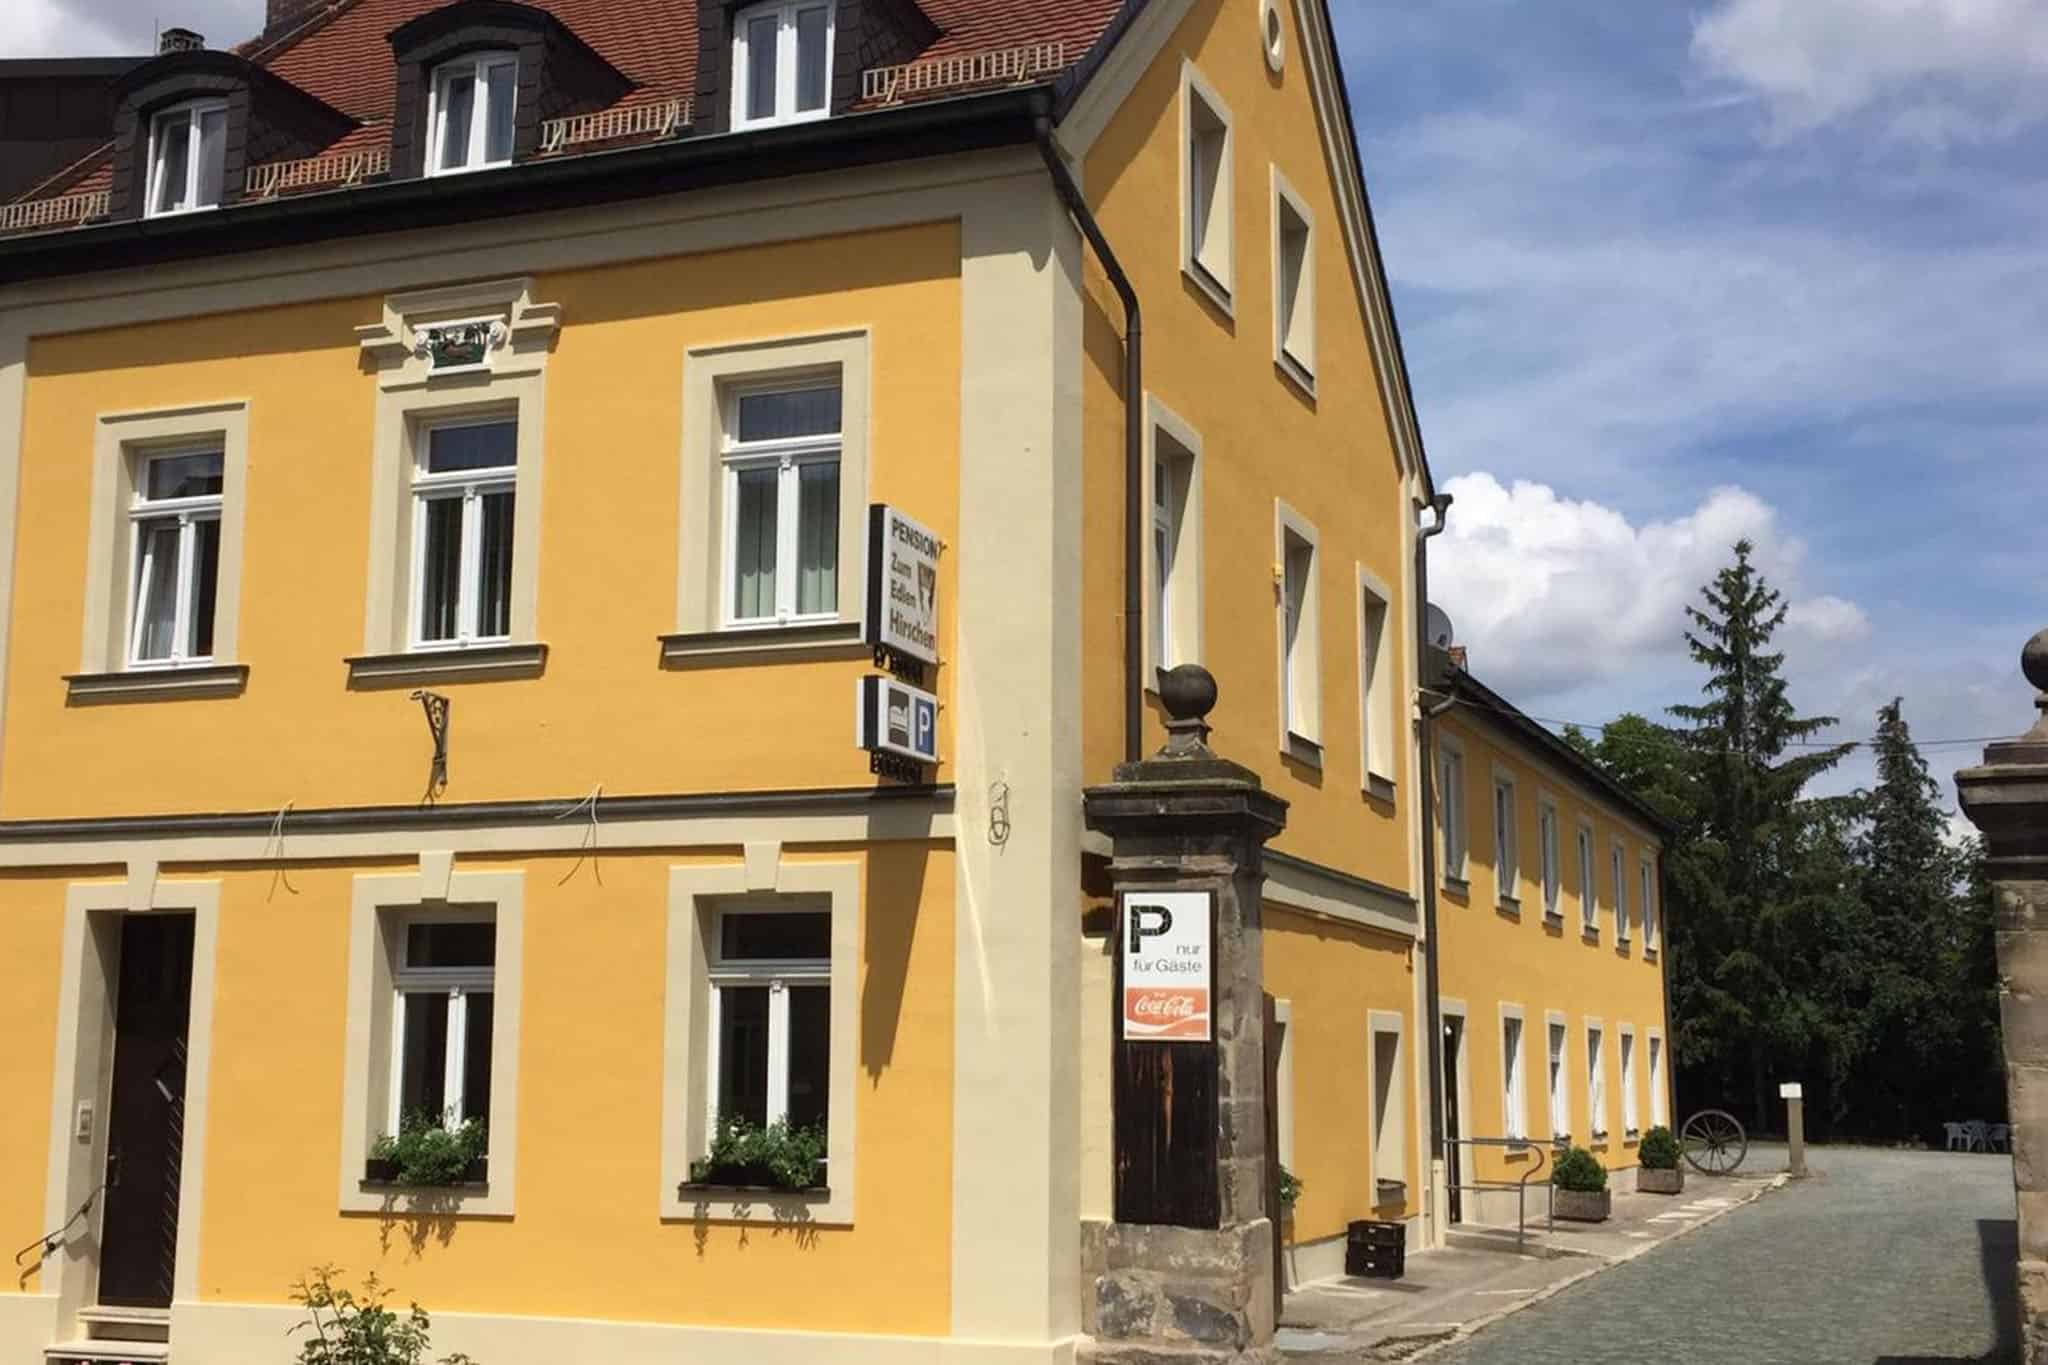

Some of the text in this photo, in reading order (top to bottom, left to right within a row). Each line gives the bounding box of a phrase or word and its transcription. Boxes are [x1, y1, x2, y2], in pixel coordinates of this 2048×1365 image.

[891, 517, 937, 556] PENSION
[891, 553, 912, 578] Zum
[890, 579, 916, 609] Edlen
[889, 609, 935, 650] Hirschen
[919, 705, 932, 746] P
[1130, 905, 1172, 953] P
[1133, 958, 1202, 972] für Gäste
[1176, 944, 1200, 955] nur
